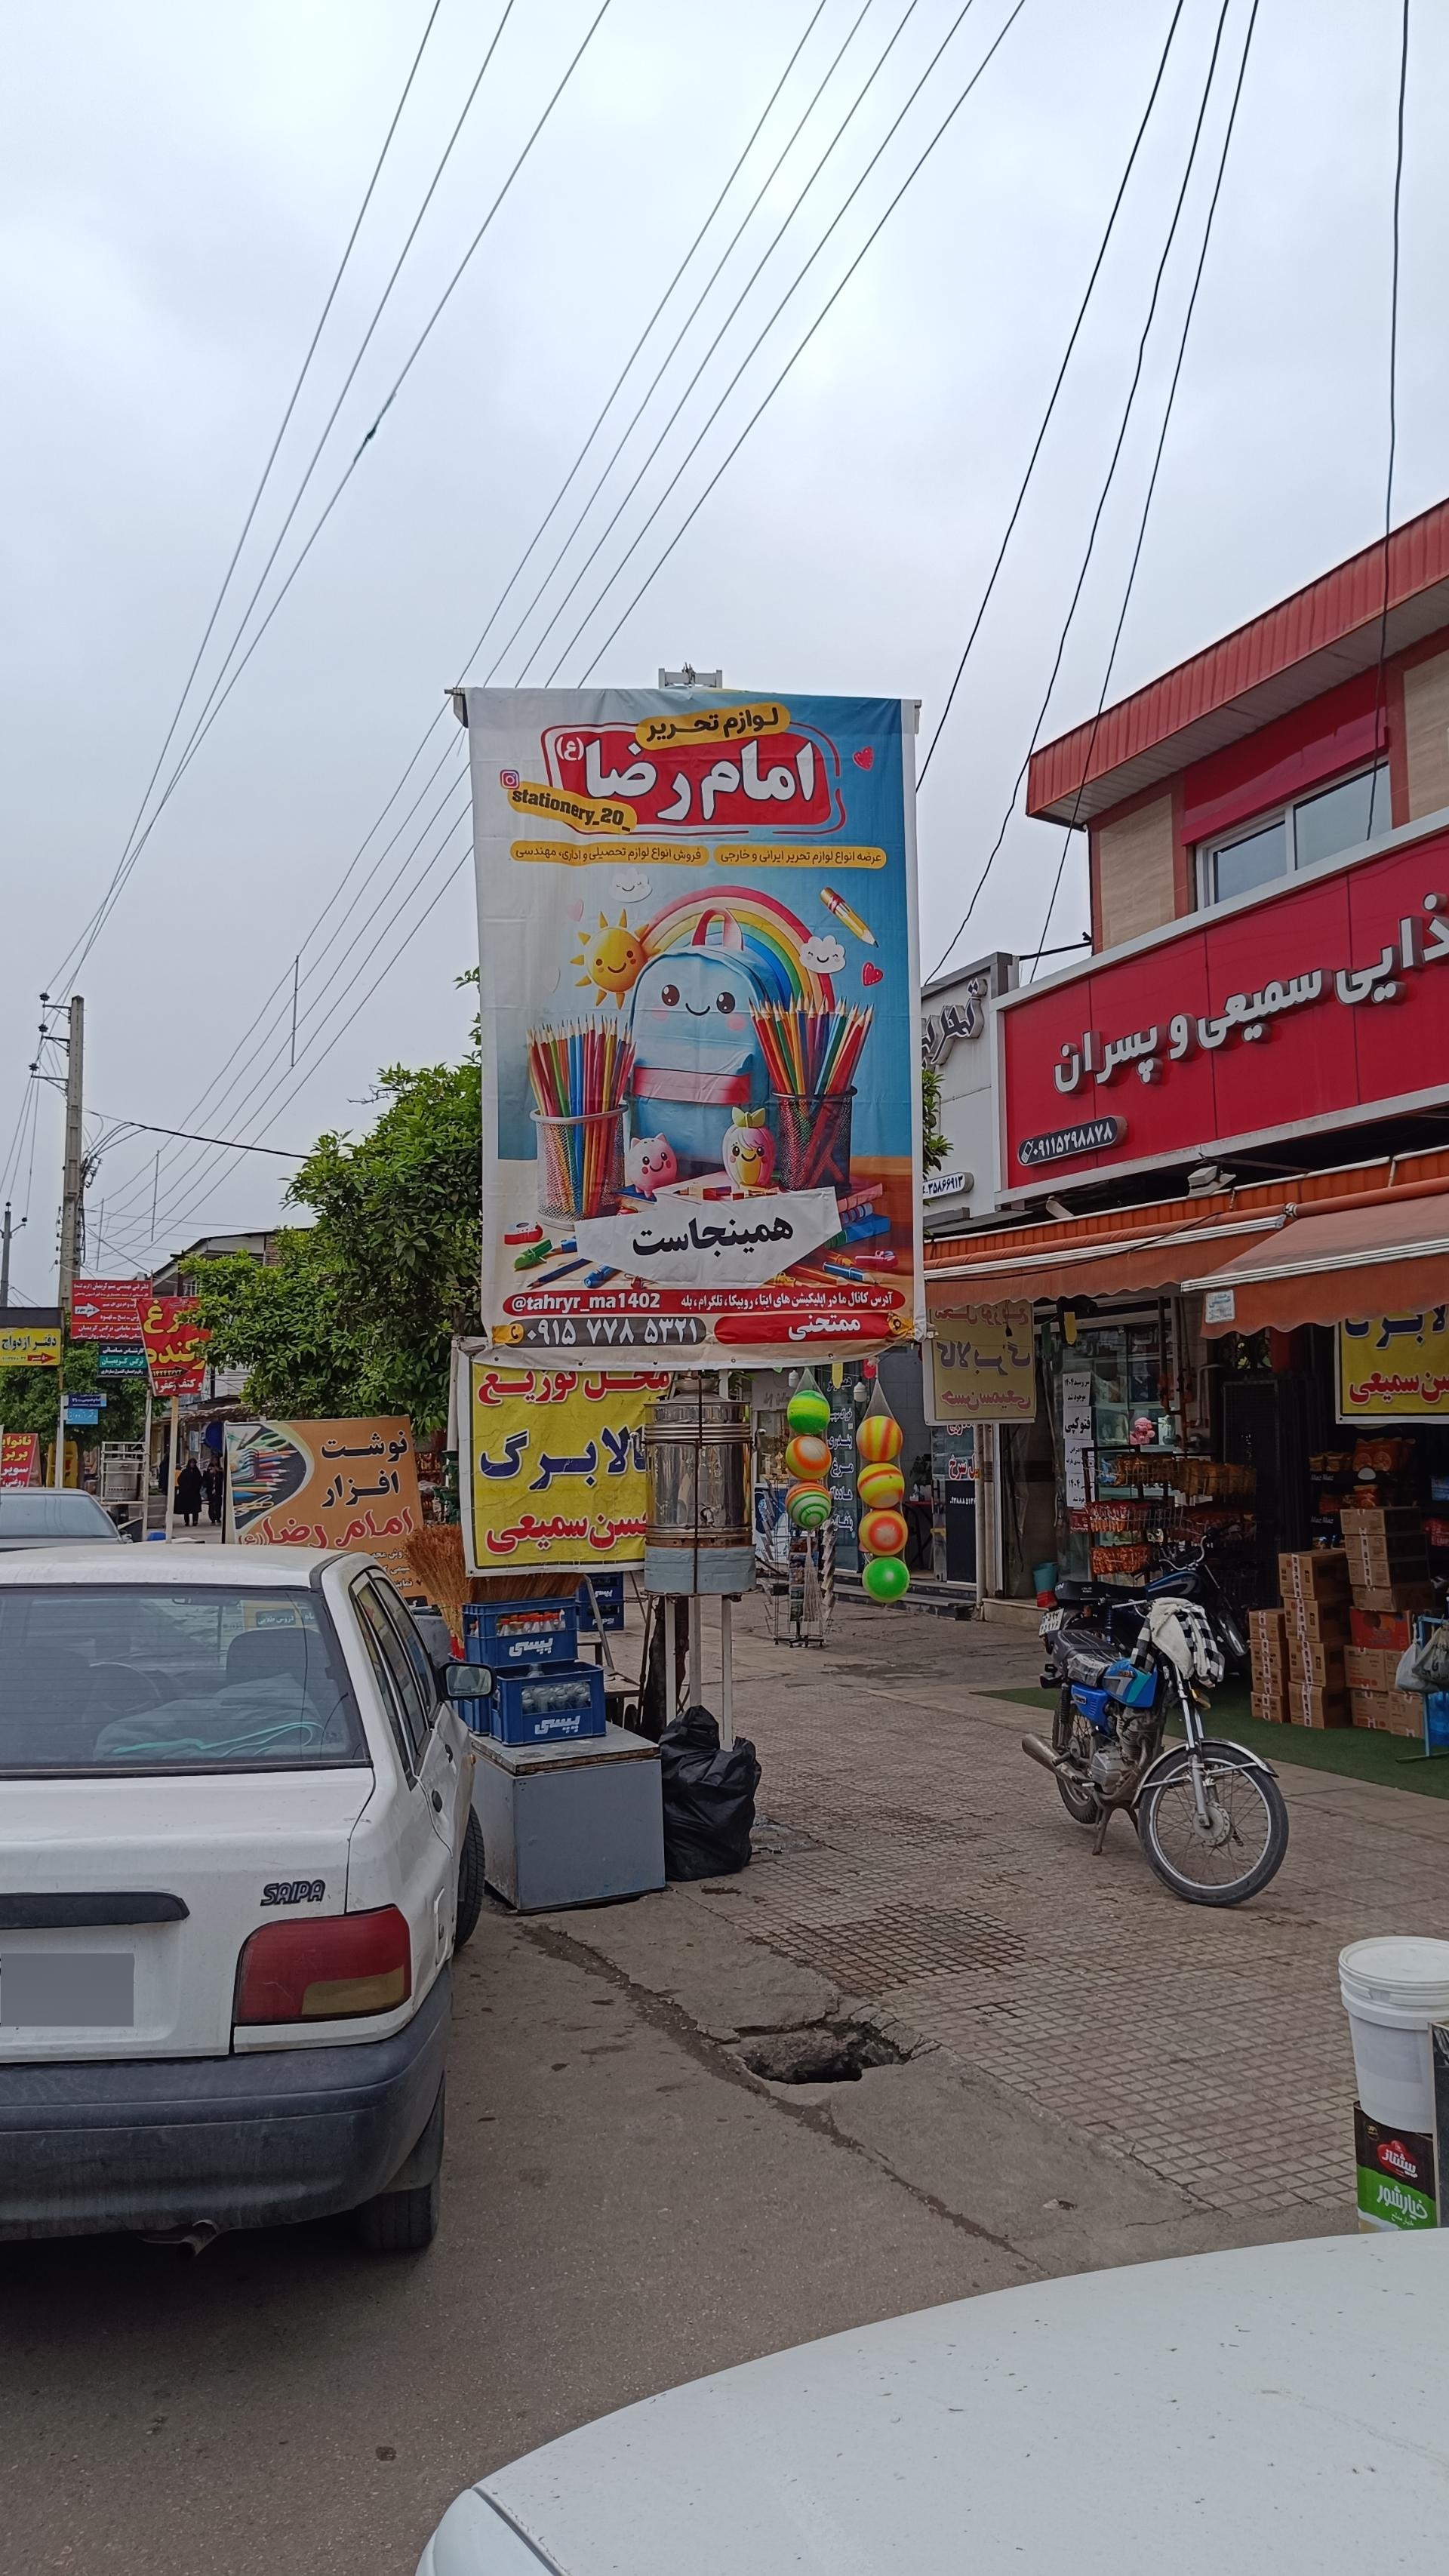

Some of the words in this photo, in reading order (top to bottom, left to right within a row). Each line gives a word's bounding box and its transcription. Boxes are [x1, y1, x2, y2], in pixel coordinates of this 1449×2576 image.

[646, 714, 719, 743] تحریر
[722, 706, 780, 737] لوازم
[585, 740, 691, 820] رضا
[701, 739, 815, 820] امام
[512, 789, 632, 832] stationery_20_
[516, 846, 556, 859] مهندسی
[583, 853, 588, 861] و
[589, 847, 626, 861] تحصیلی
[628, 847, 649, 862] لوازم
[651, 845, 671, 861] انواع
[674, 845, 701, 863] فروش
[721, 849, 749, 863] خارجی
[760, 851, 783, 863] ایرانی
[787, 851, 810, 863] تحریر
[813, 851, 832, 864] لوازم
[835, 851, 854, 863] انواع
[857, 854, 881, 864] عرضه
[1335, 892, 1449, 1006] ذایی
[1198, 968, 1324, 1050] سمیعی
[1169, 1014, 1192, 1060] و
[1054, 1024, 1159, 1094] پسران
[1033, 1122, 1112, 1156] ۰۹۱۱۵۲۹۸۸۷۸
[632, 1217, 794, 1257] همینجاست
[512, 1292, 660, 1313] @tahryr_ma1402
[681, 1294, 692, 1309] بله
[774, 1293, 790, 1305] های
[791, 1292, 826, 1309] اپلیکیشن
[827, 1296, 837, 1307] در
[839, 1294, 846, 1305] ما
[848, 1292, 869, 1307] کانال
[870, 1291, 892, 1307] آدرس
[143, 1299, 181, 1334] رغ
[528, 1319, 576, 1345] ۰۹۱۵
[586, 1318, 635, 1344] ۷۷۸
[644, 1318, 697, 1343] ۵۳۲۱
[788, 1314, 861, 1340] ممتحنی
[2, 1335, 30, 1351] ازدواج
[32, 1334, 57, 1351] دفتر
[1349, 1371, 1420, 1405] سمیعی
[1065, 1416, 1090, 1433] فتوکپی
[2, 1436, 31, 1448] نانوای
[321, 1430, 408, 1463] نوشت
[2, 1451, 28, 1461] بربر
[830, 1457, 854, 1477] مرغ
[321, 1469, 400, 1508] افزار
[262, 1516, 328, 1549] رضا
[335, 1507, 414, 1549] امام
[485, 1512, 589, 1556] سمیعی
[592, 1617, 614, 1626] PPSI
[509, 1638, 553, 1657] پپسی
[534, 1716, 580, 1734] پپسی
[260, 1880, 325, 1906] SAIPA
[1377, 2184, 1429, 2220] خیارشور
